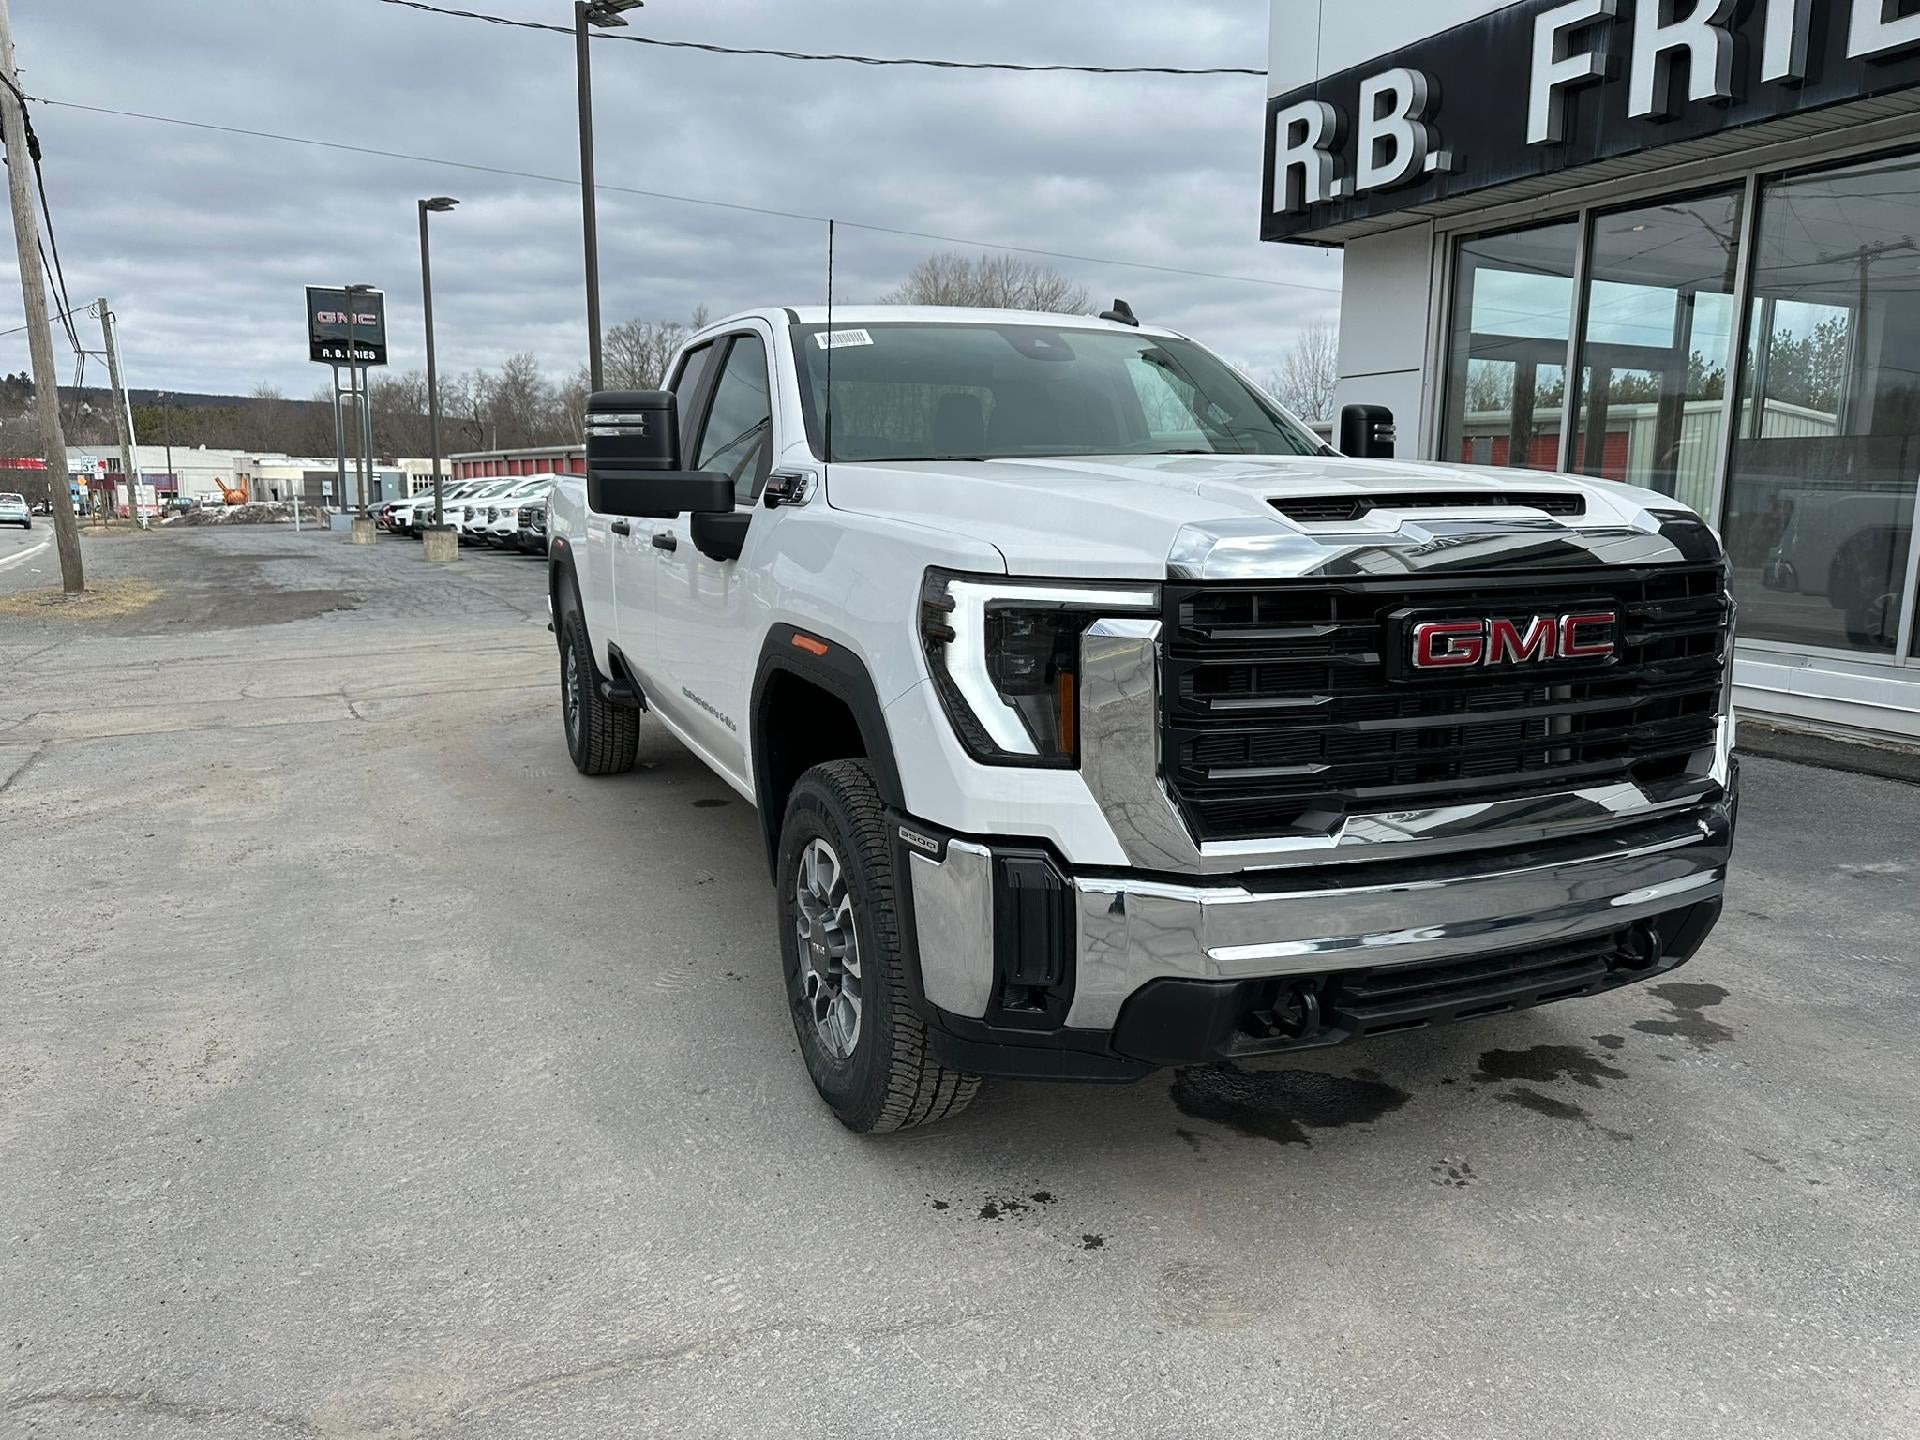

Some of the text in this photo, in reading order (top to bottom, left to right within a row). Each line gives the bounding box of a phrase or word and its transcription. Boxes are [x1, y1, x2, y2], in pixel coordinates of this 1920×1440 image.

[1272, 67, 1452, 214] R.B.
[317, 311, 376, 325] GMC
[1412, 611, 1616, 668] GMC
